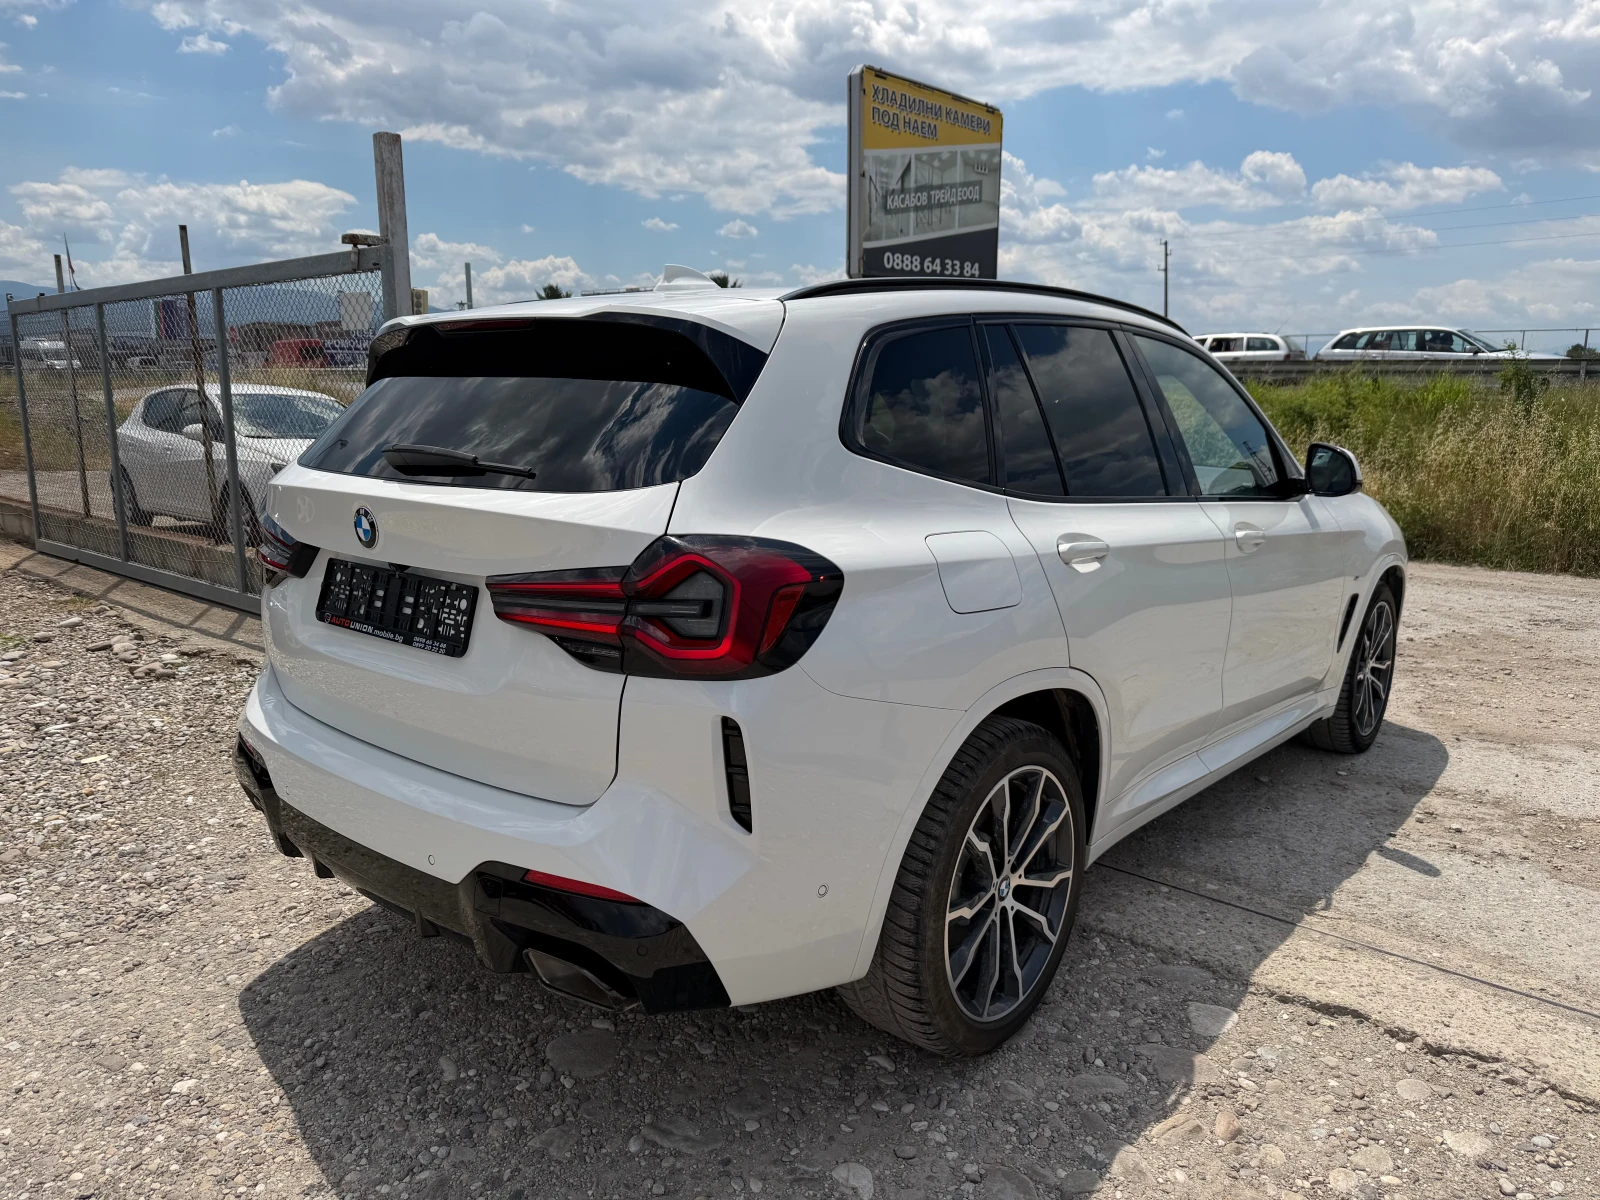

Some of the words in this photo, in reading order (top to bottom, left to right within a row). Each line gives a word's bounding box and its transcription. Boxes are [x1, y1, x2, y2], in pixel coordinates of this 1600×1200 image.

[872, 83, 943, 121] ХЛАДИЛНИ
[945, 105, 992, 134] КАМЕРИ
[872, 106, 900, 133] ПОД
[903, 115, 938, 139] НАЕМ
[886, 192, 928, 210] КАСАБОВ
[930, 186, 956, 205] ТРЕЙД
[957, 185, 980, 202] ЕООД
[883, 251, 921, 272] 0888
[923, 257, 941, 274] 64
[944, 259, 961, 276] 33
[963, 261, 980, 278] 84
